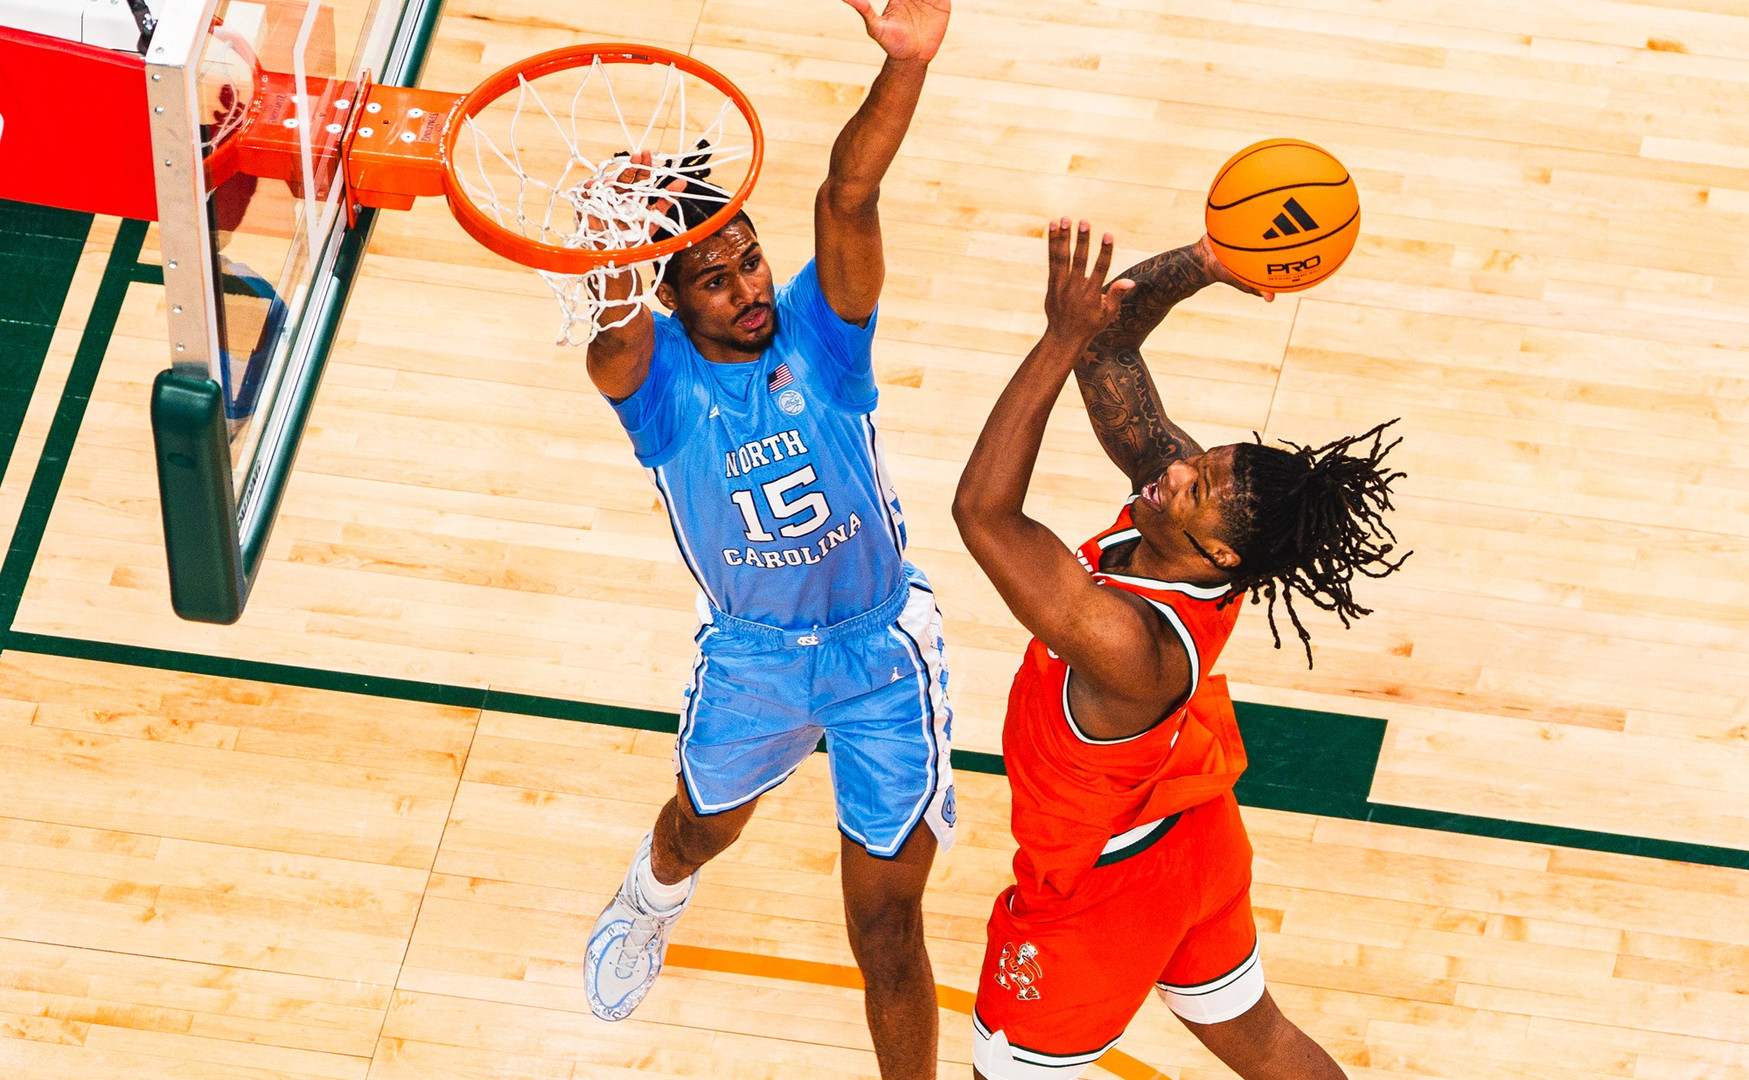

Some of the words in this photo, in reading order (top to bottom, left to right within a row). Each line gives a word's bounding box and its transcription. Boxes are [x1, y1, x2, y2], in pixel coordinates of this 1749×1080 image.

[1267, 255, 1321, 275] PRO
[725, 429, 809, 478] NORTH
[730, 463, 832, 543] 15
[722, 512, 862, 568] CAROLINA
